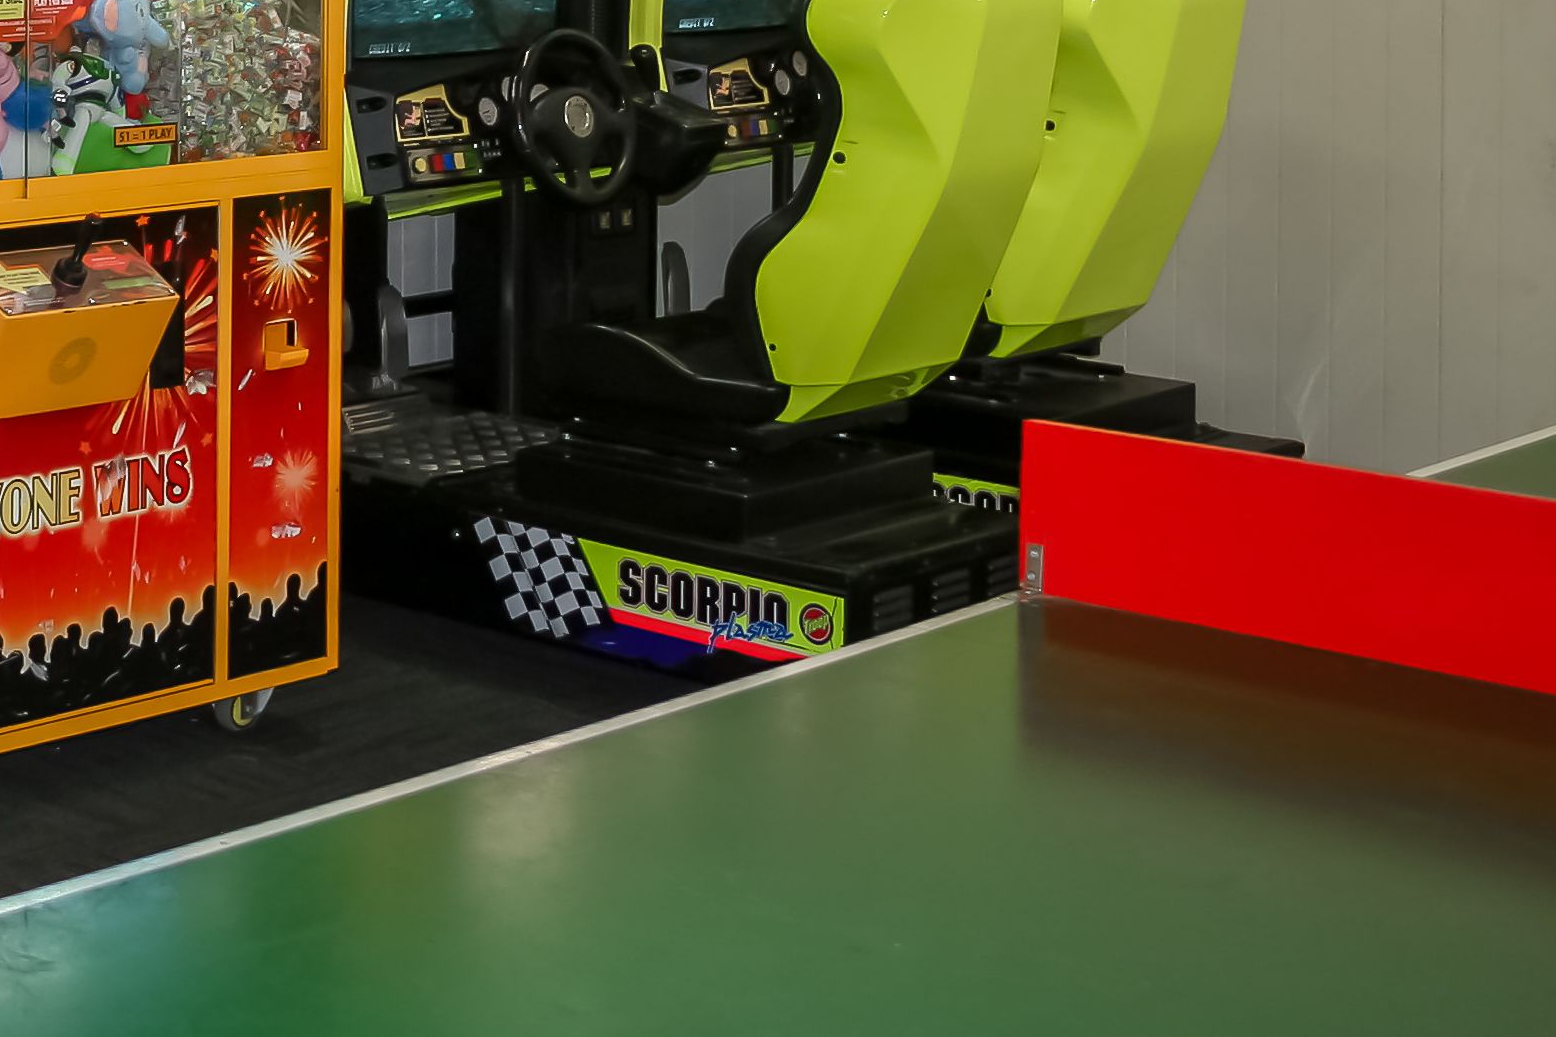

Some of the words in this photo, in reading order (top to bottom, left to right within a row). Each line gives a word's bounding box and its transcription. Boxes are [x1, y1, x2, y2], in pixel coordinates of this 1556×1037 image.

[149, 127, 173, 140] PLAY
[93, 446, 192, 518] WINS
[617, 557, 792, 634] SCORPIO
[707, 611, 794, 654] plasma
